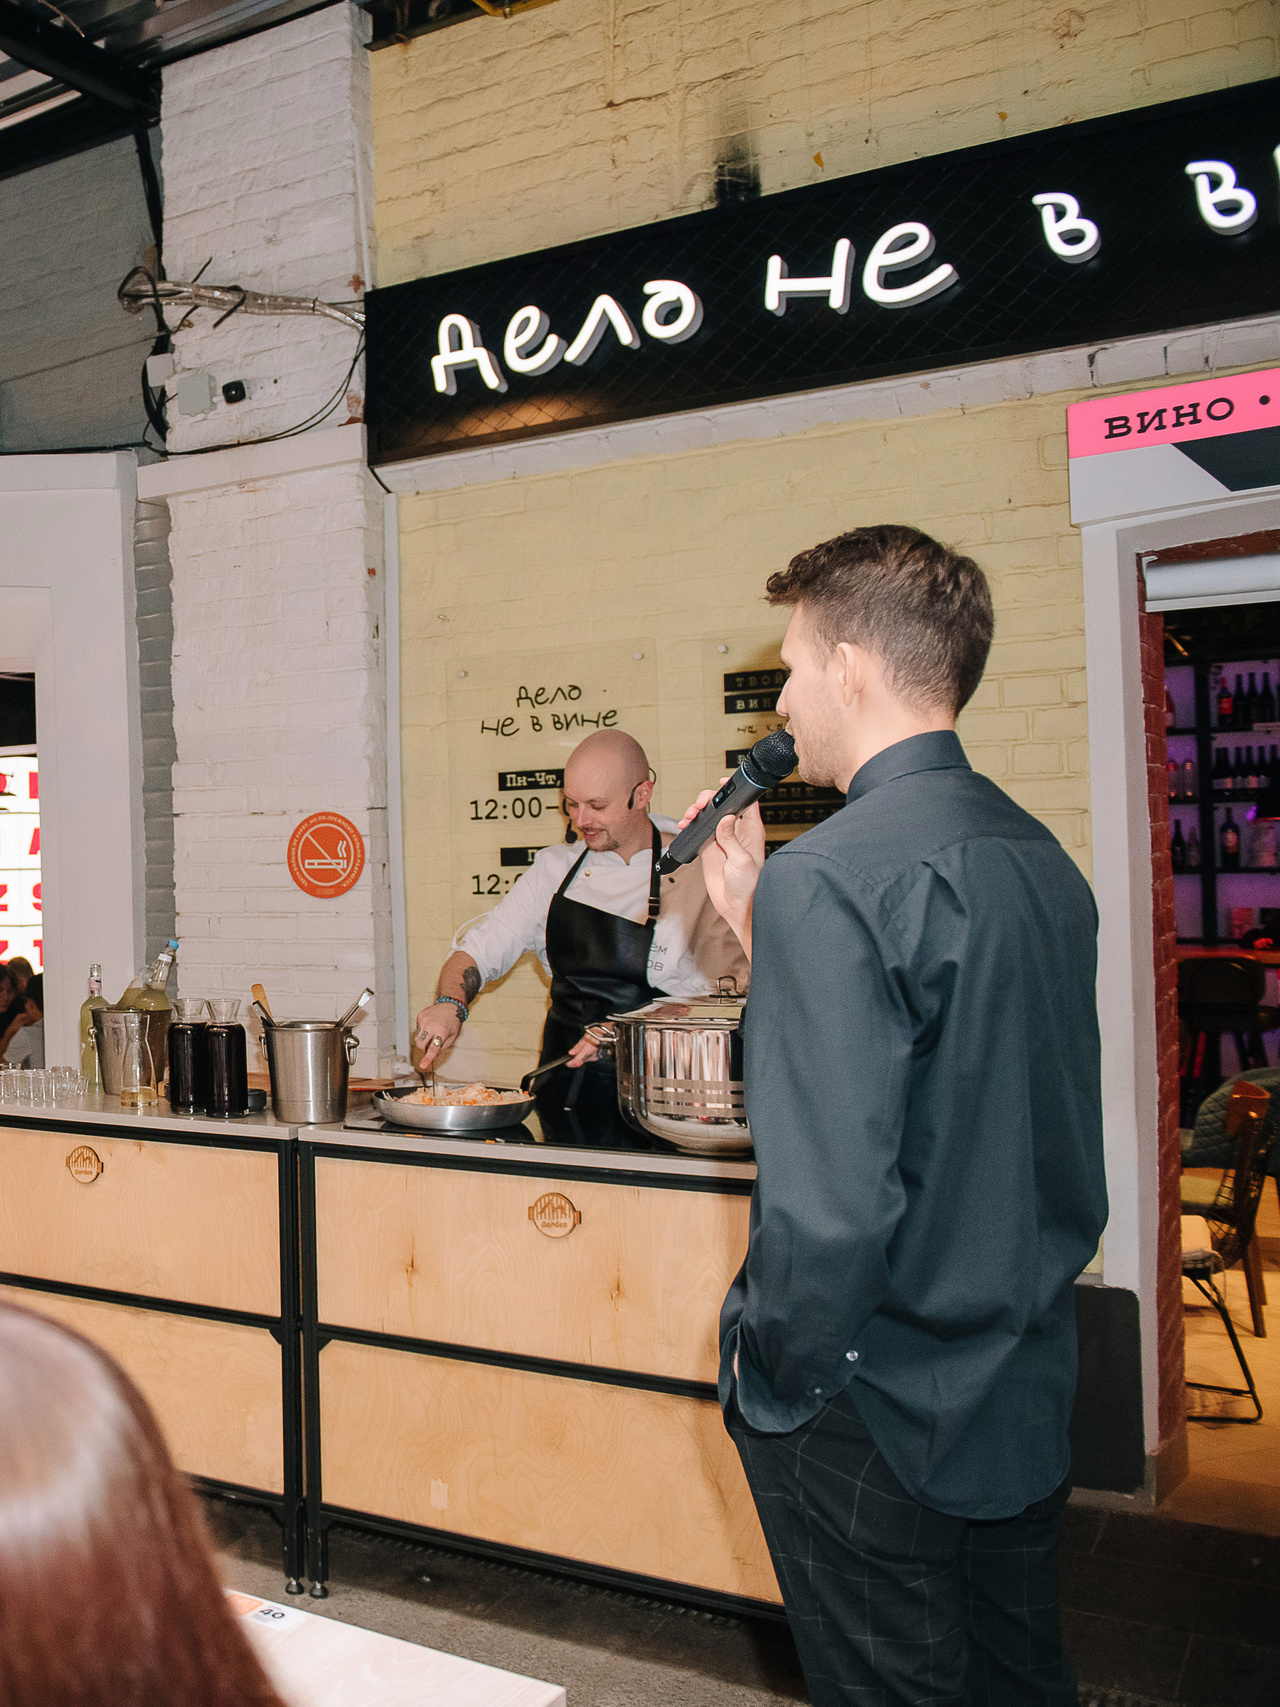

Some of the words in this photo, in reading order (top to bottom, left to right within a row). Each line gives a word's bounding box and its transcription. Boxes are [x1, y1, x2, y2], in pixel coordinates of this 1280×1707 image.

[430, 279, 701, 395] дело
[764, 222, 957, 315] не
[1032, 191, 1100, 263] в
[1185, 144, 1280, 235] в
[1104, 397, 1234, 440] ВИНО
[516, 684, 582, 709] дело
[480, 717, 520, 737] не
[530, 715, 543, 732] в
[551, 709, 618, 731] вине
